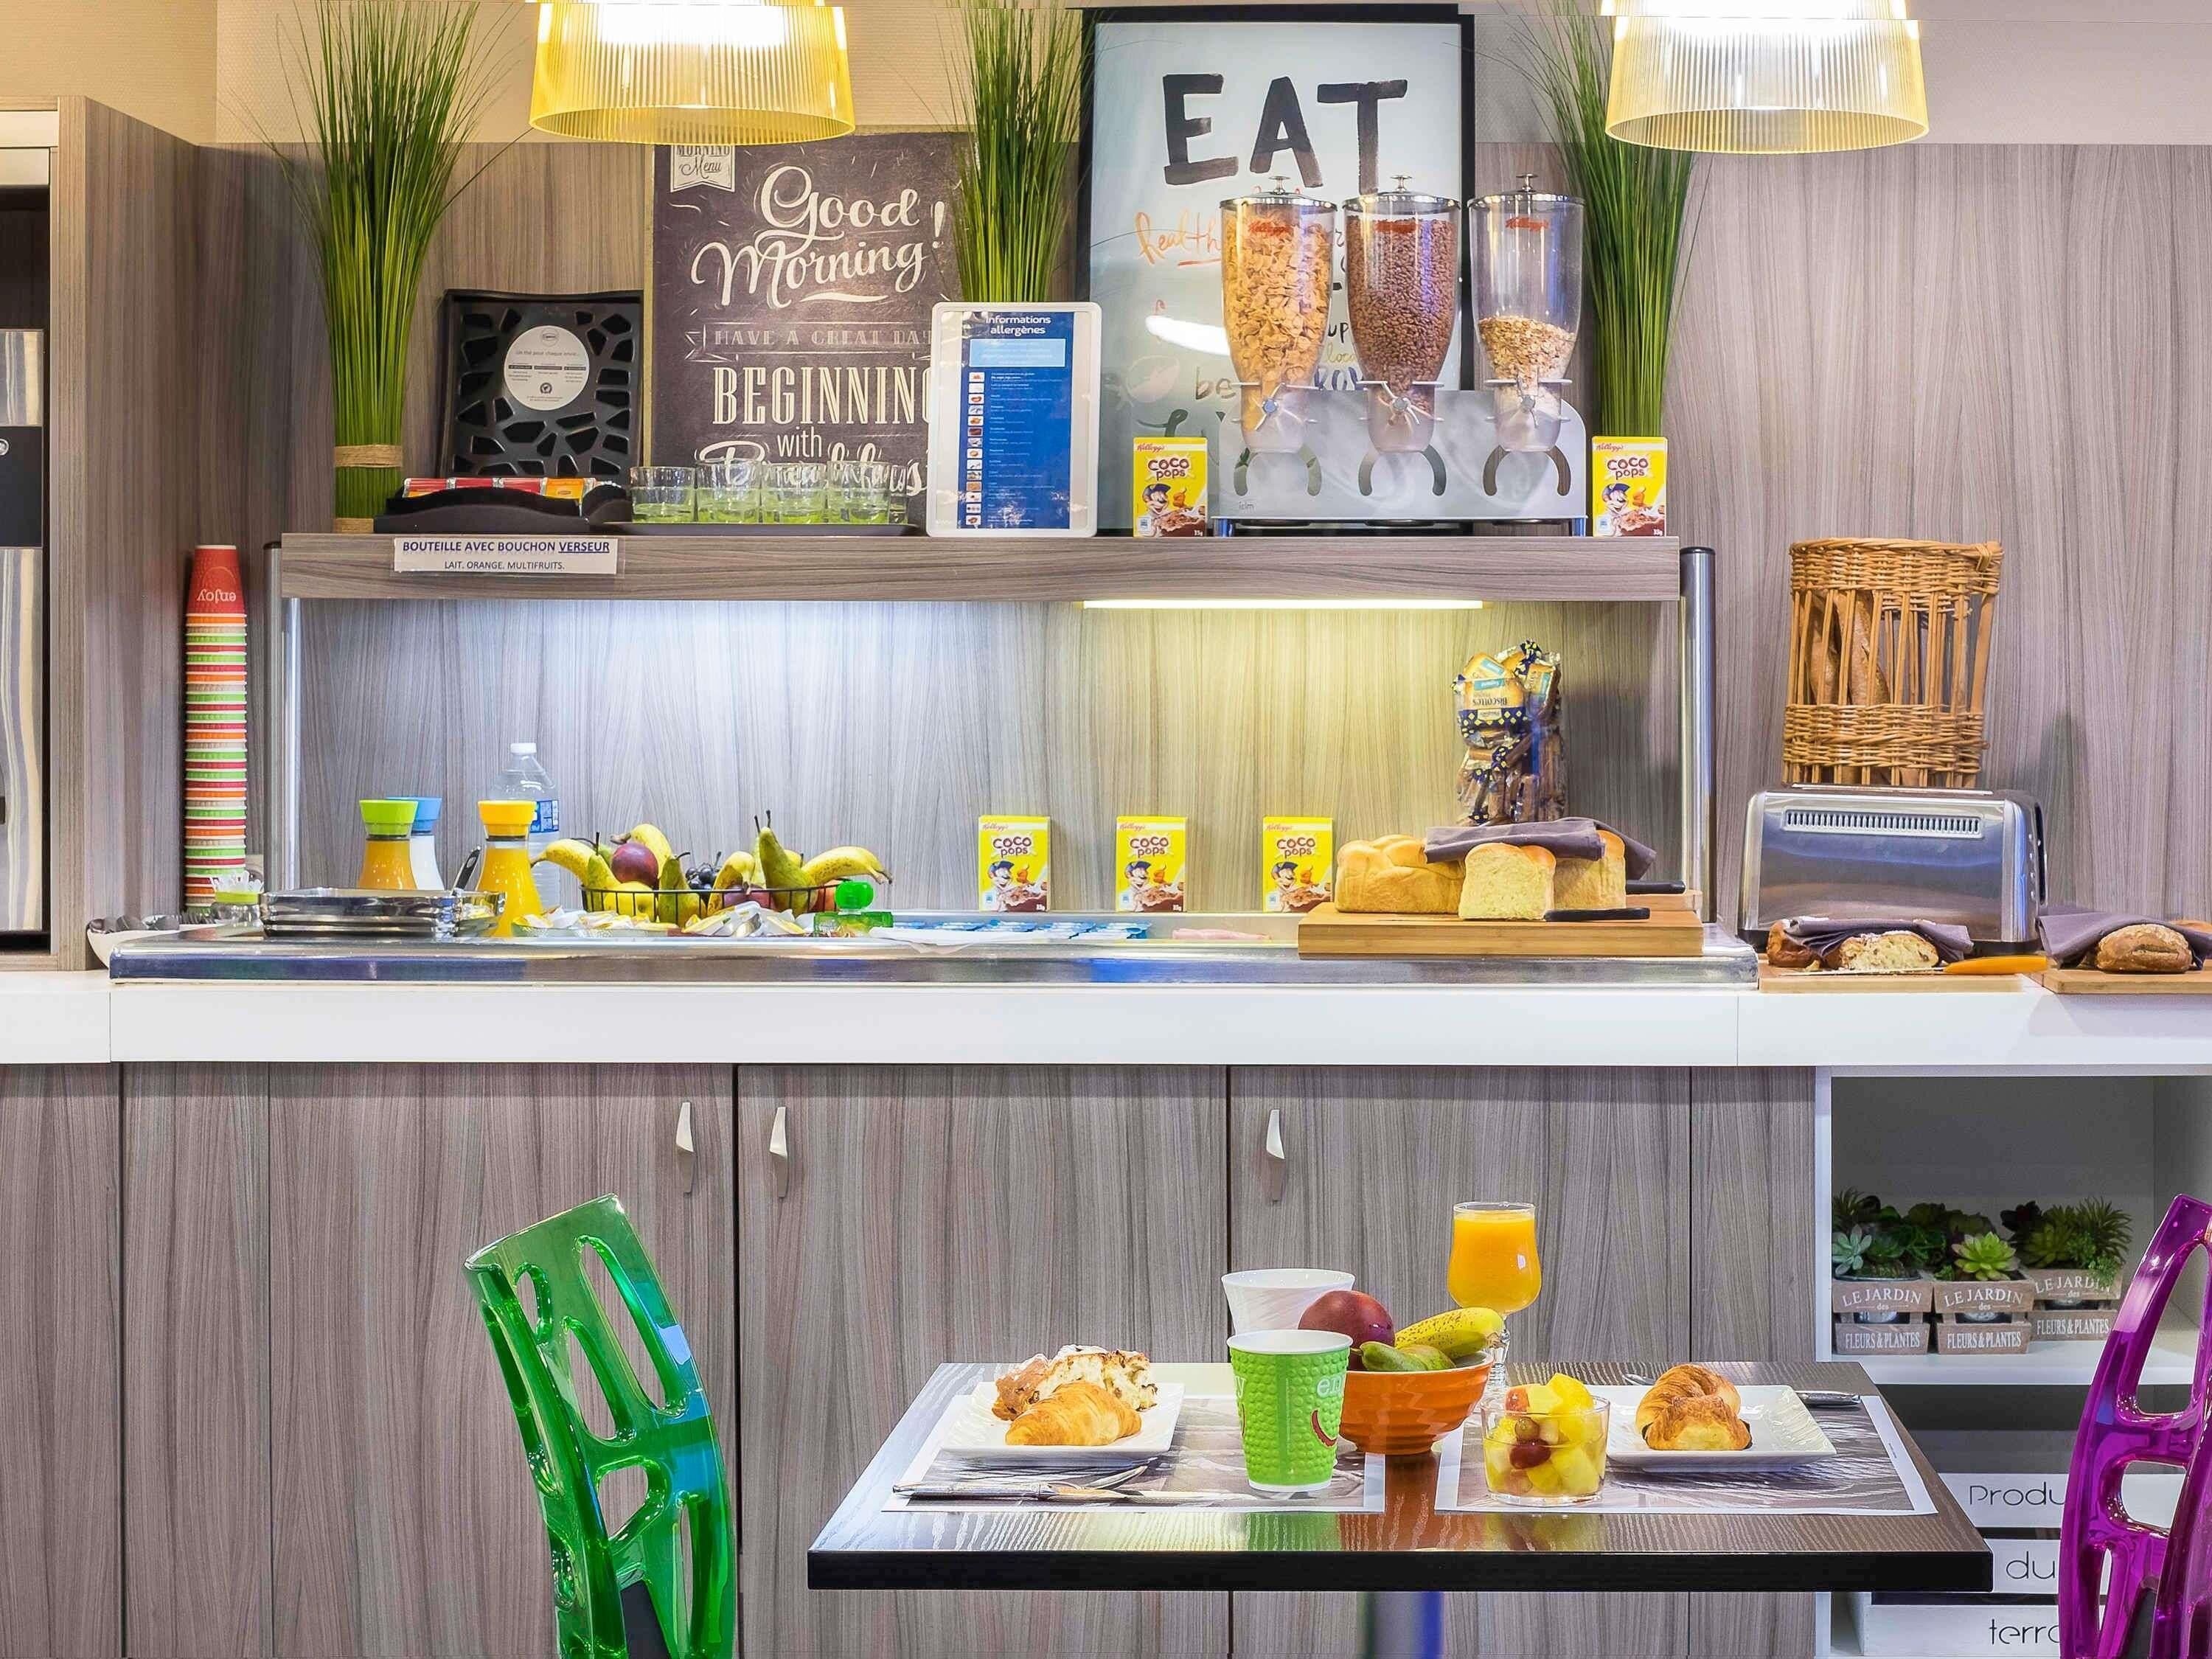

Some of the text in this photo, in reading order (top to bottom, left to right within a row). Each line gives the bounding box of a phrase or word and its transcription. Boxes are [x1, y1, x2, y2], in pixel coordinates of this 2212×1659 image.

[1163, 74, 1408, 195] EAT
[679, 153, 722, 179] Menu
[755, 166, 920, 260] Good
[715, 330, 775, 345] HAVE
[785, 330, 800, 345] A
[990, 324, 1046, 337] allergènes
[777, 426, 822, 458] with
[1156, 469, 1186, 481] pops
[1615, 468, 1645, 480] pops
[403, 541, 611, 553] BOUTEILLE AVEC BOUCHON VERSEUR
[444, 561, 565, 570] LAIT. ORANGE. MULTIFRUITS.
[196, 588, 237, 604] enjoy
[1001, 846, 1028, 858] pops
[1138, 846, 1165, 858] pops
[1284, 847, 1312, 859] pops
[2035, 1278, 2053, 1294] LE
[1843, 1288, 1922, 1307] LE JARDIN
[1944, 1288, 2024, 1307] LE JARDIN
[2068, 1290, 2080, 1298] des
[1978, 1302, 1991, 1310] des
[2006, 1551, 2056, 1579] du
